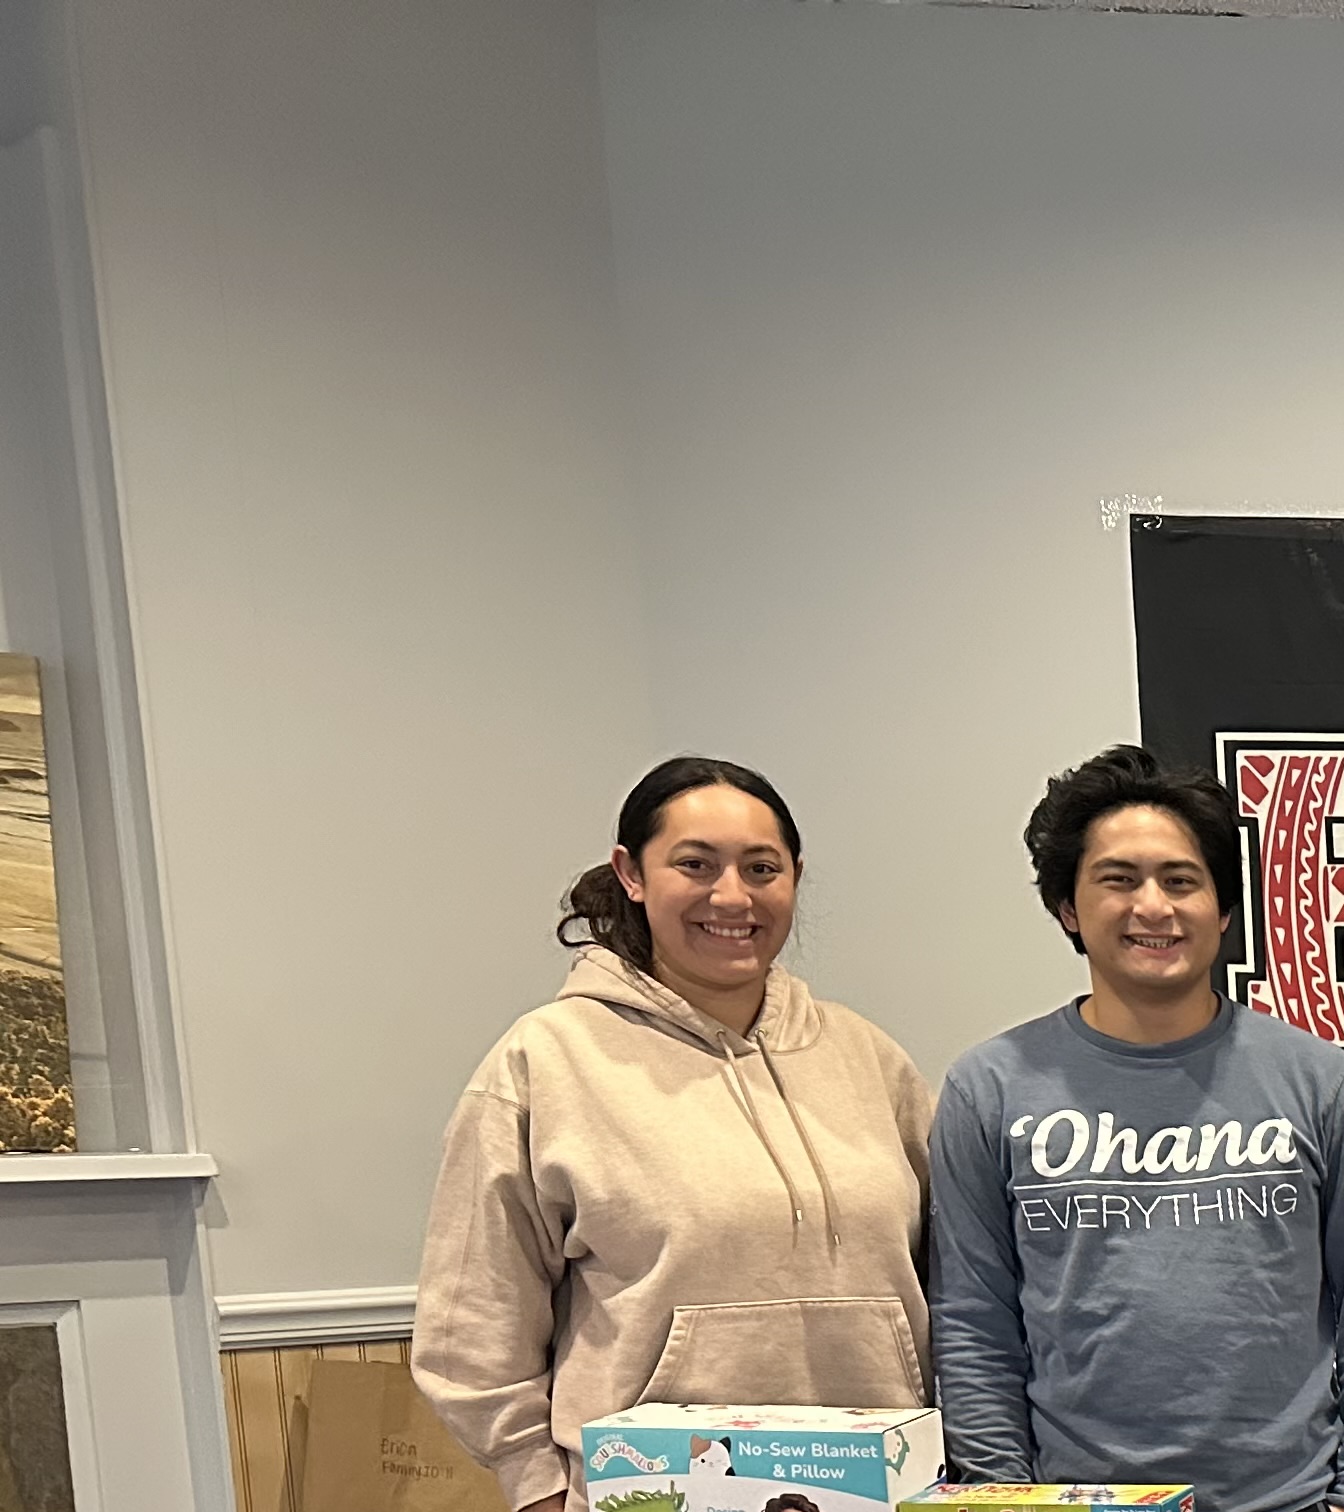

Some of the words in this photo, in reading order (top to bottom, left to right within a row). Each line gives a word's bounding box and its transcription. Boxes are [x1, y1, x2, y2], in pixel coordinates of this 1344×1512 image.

[1010, 1109, 1297, 1177] ‘Ohana
[1021, 1183, 1297, 1231] EVERYTHING
[739, 1442, 806, 1458] No-Sew
[811, 1443, 878, 1458] Blanket
[772, 1466, 785, 1478] &
[792, 1465, 845, 1479] Pillow
